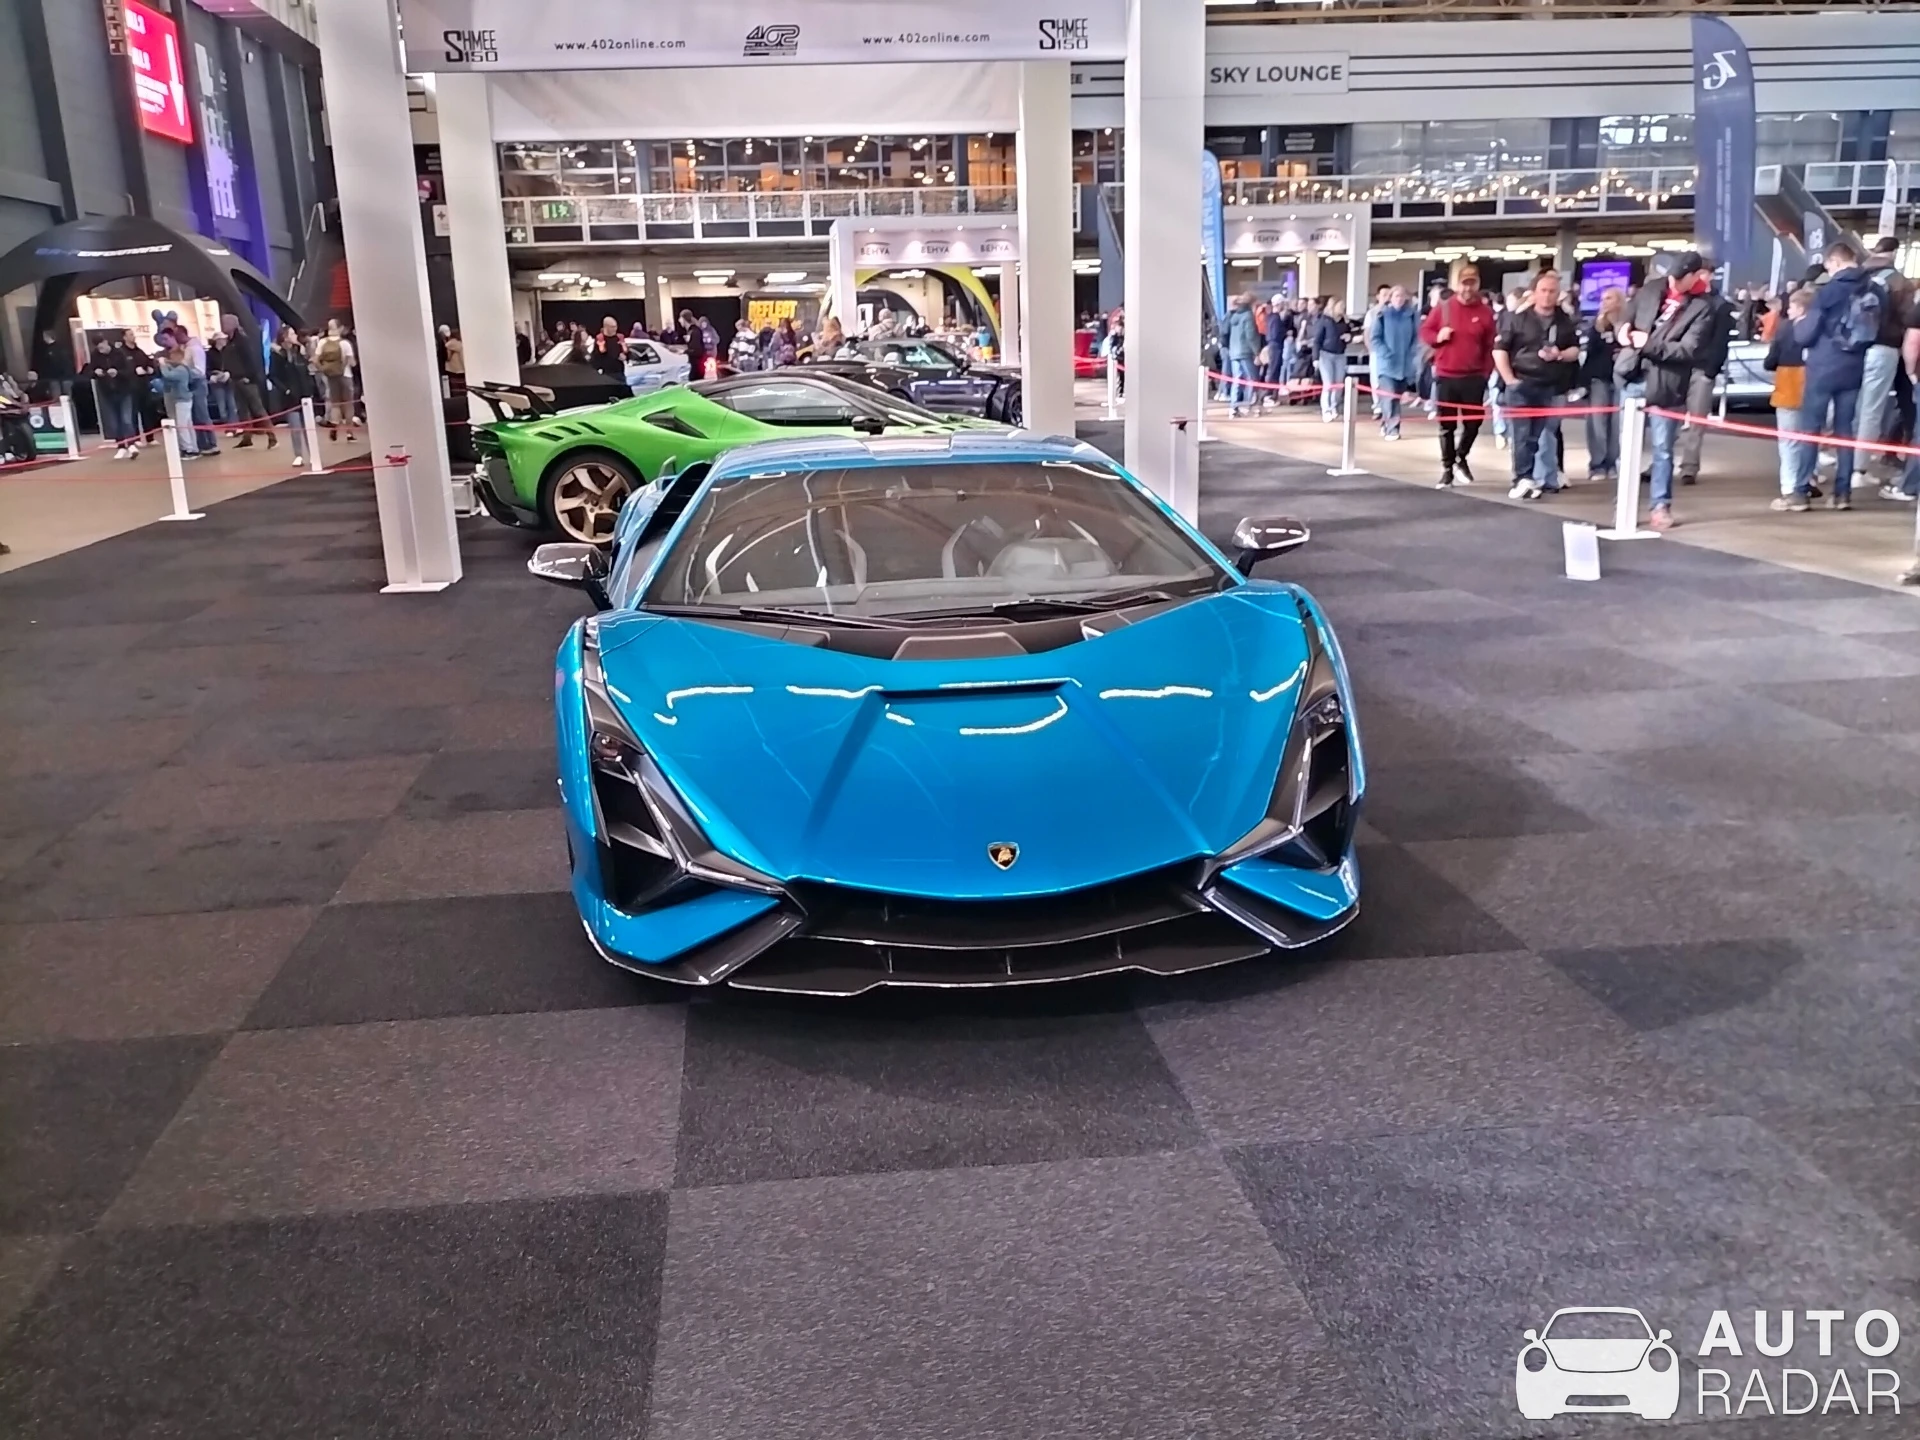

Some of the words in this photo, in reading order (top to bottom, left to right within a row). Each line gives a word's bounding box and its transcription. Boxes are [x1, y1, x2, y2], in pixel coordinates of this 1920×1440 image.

[746, 24, 800, 47] 402
[862, 32, 990, 45] www.402online.com
[1039, 18, 1088, 50] SHMEE
[1057, 38, 1088, 50] 150
[443, 30, 497, 62] SHMEE
[554, 38, 686, 51] www.402online.com
[463, 51, 498, 63] 150
[1210, 66, 1250, 84] SKY
[1256, 64, 1342, 82] LOUNGE
[748, 300, 798, 320] REFLECT
